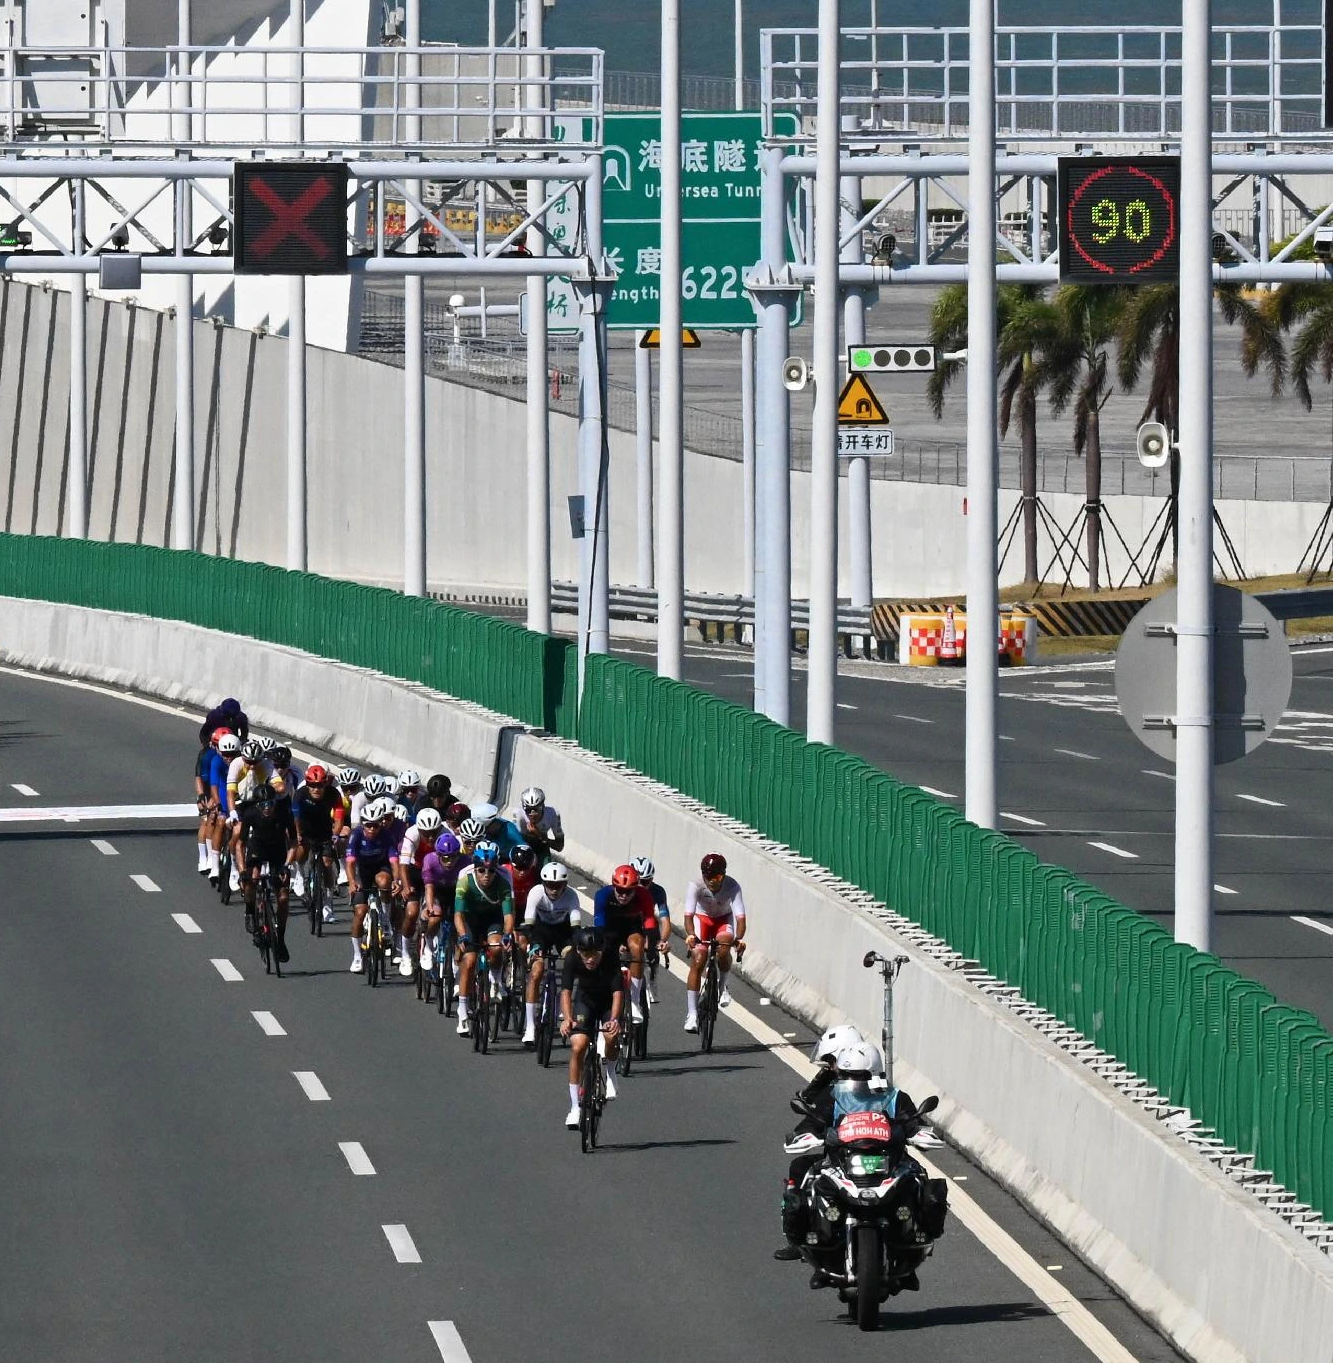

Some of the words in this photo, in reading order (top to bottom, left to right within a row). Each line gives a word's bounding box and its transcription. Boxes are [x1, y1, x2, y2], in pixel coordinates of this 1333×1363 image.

[725, 183, 762, 198] Tunn
[1091, 198, 1151, 244] 90
[611, 285, 660, 304] ength
